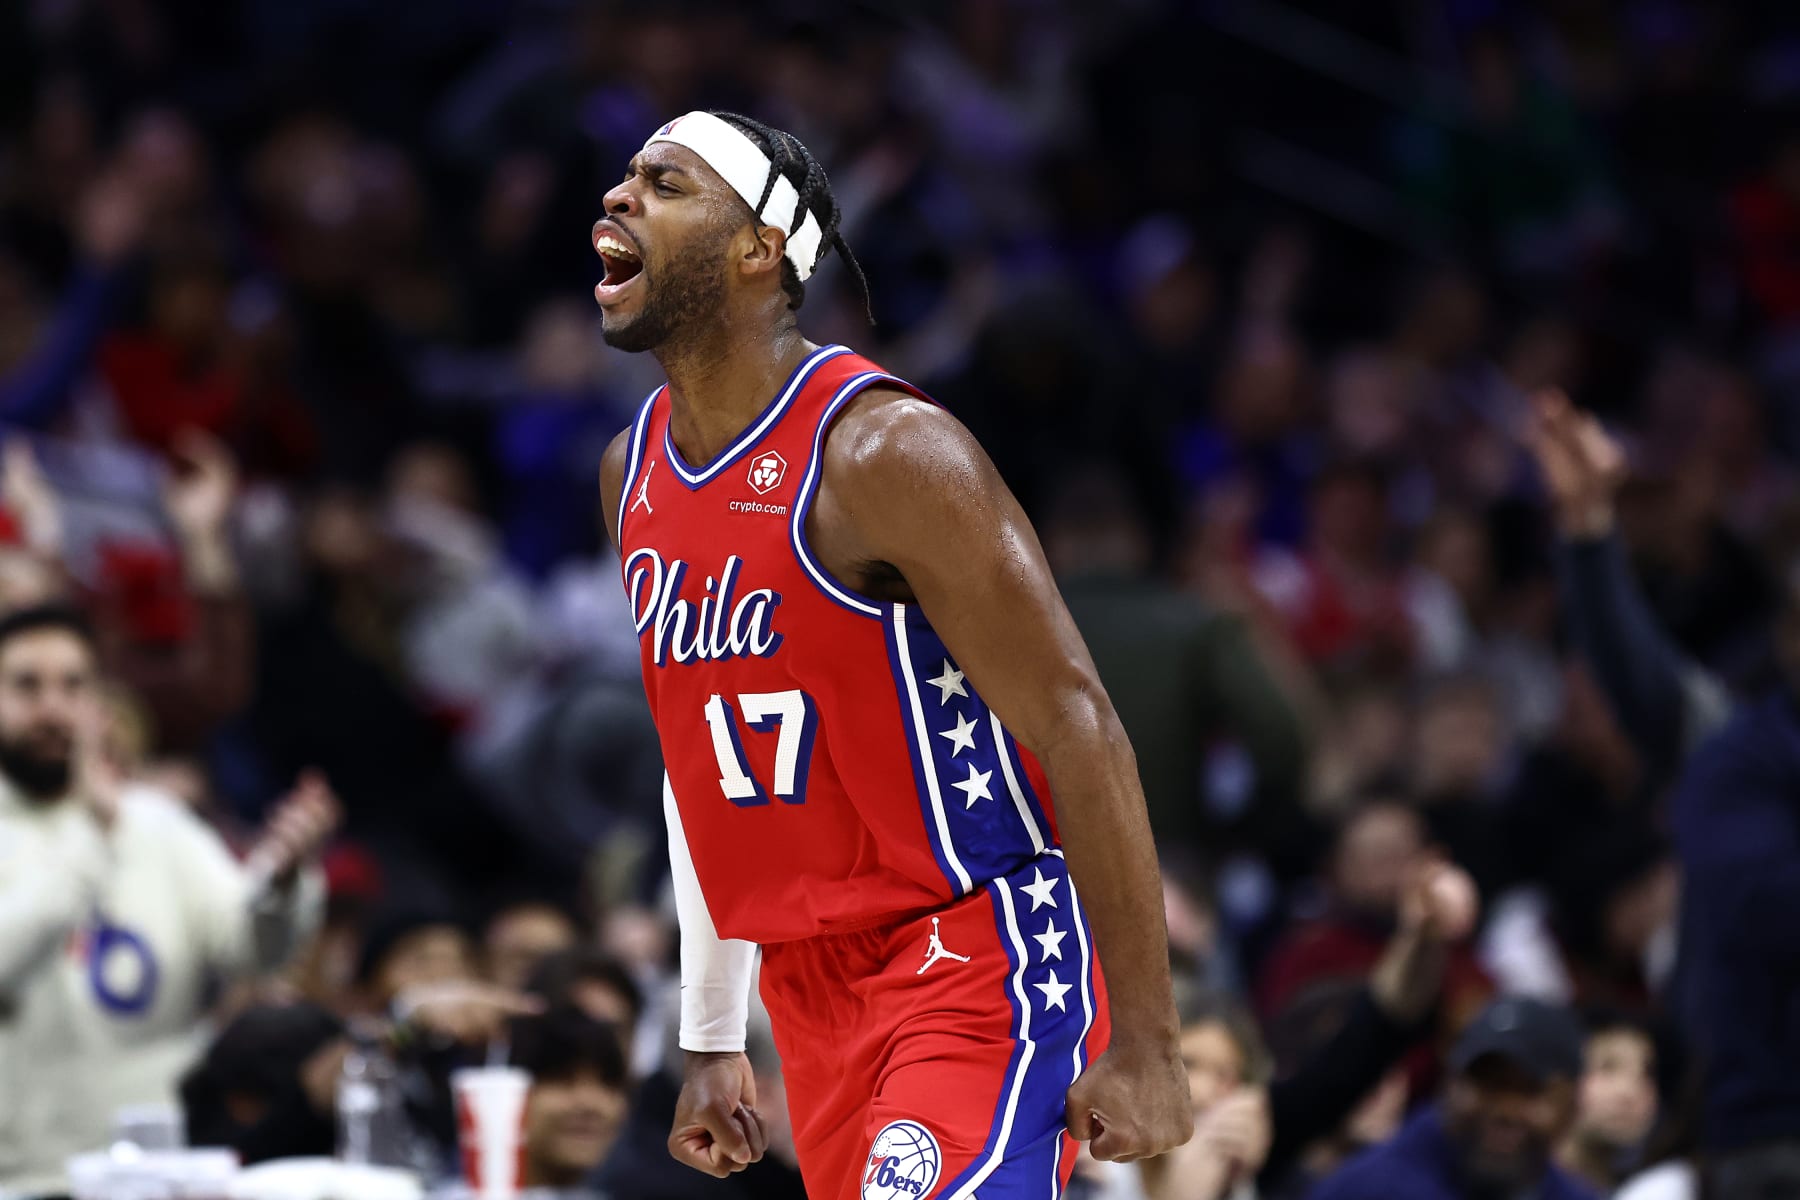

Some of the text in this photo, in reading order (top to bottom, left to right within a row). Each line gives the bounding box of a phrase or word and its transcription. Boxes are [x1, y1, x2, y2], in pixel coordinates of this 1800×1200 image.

[729, 500, 787, 515] crypto.com
[624, 548, 783, 667] Phila
[704, 689, 818, 807] 17
[865, 1152, 923, 1195] 76ers
